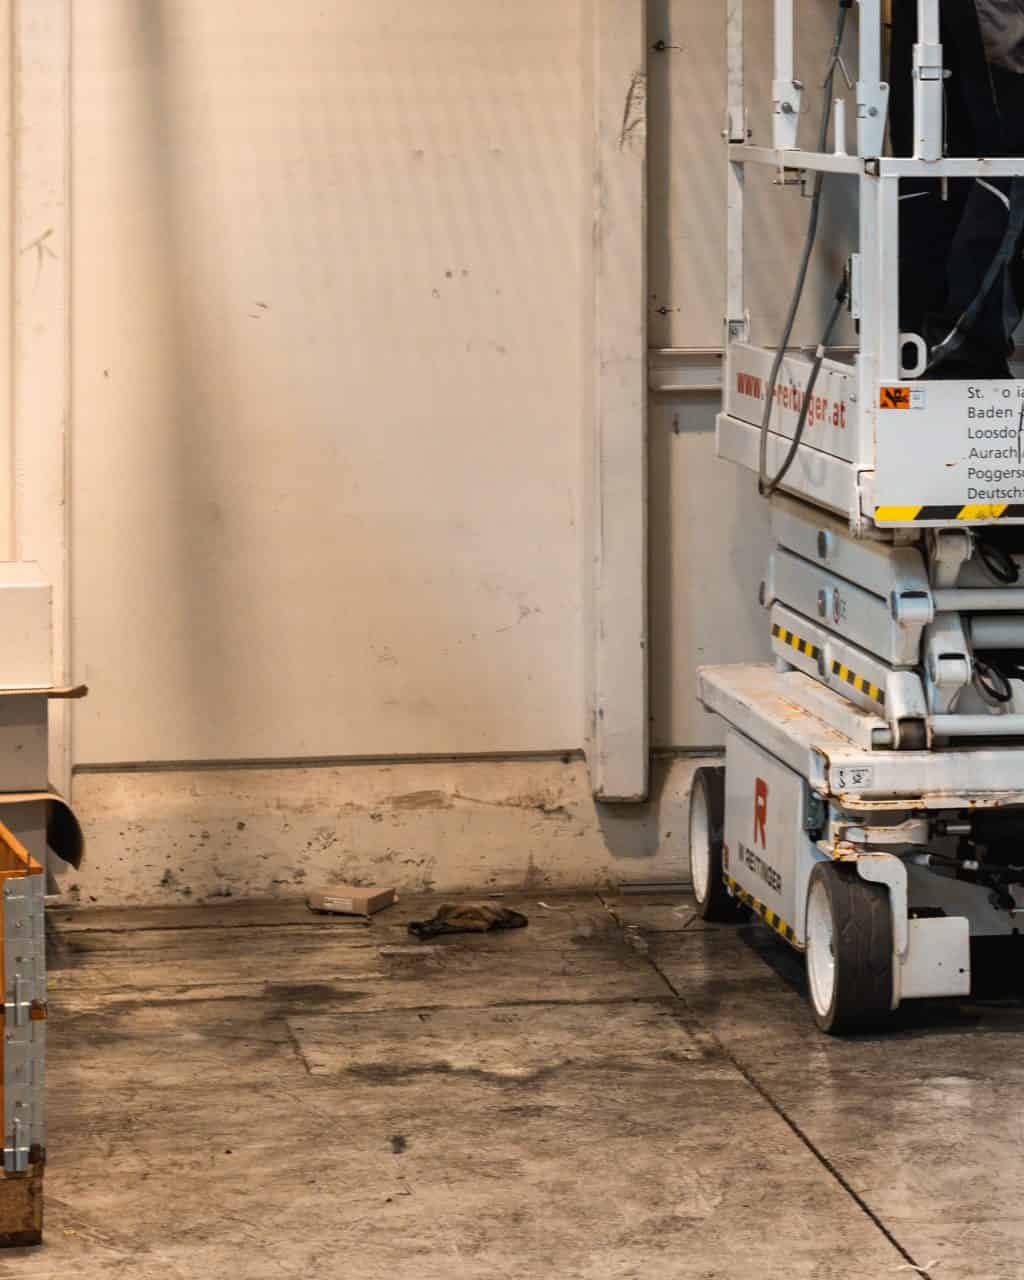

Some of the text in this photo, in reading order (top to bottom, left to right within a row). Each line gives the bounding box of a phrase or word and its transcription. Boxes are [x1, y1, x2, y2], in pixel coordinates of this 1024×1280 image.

[967, 386, 985, 399] St.
[967, 405, 1013, 419] Baden
[968, 445, 1018, 459] Aurach
[753, 777, 768, 850] R
